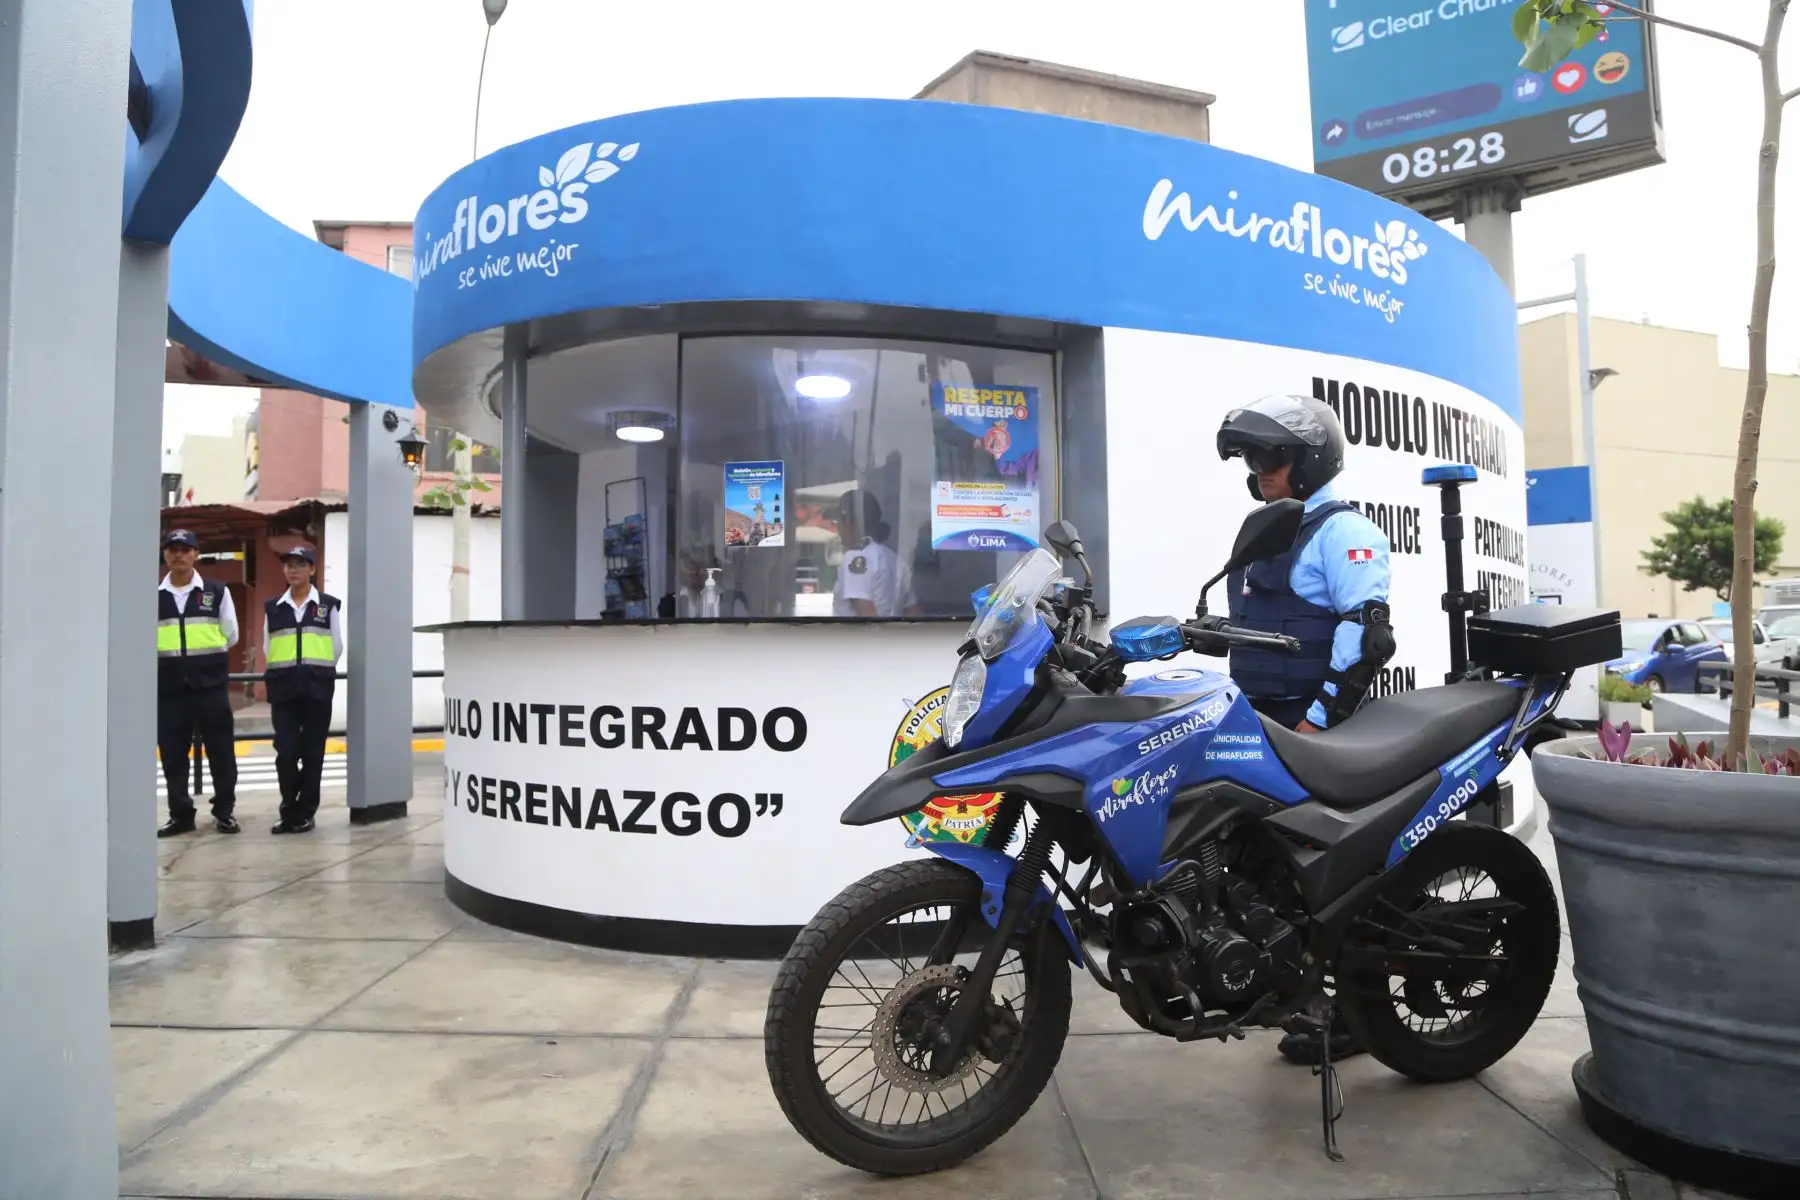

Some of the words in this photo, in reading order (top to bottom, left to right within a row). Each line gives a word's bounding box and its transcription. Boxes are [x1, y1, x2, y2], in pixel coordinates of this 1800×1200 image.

[1368, 9, 1434, 39] Clear
[1382, 131, 1505, 184] 08:28
[458, 264, 477, 289] se
[480, 254, 513, 279] vive
[516, 239, 579, 277] mejor
[1303, 272, 1326, 295] se
[1328, 273, 1361, 304] vive
[1363, 287, 1404, 323] mejor
[944, 387, 1027, 406] RESPETA
[944, 403, 963, 416] MI
[1433, 401, 1508, 479] INTEGRADO
[980, 538, 1006, 547] LIMA
[492, 702, 808, 753] INTEGRADO
[1138, 701, 1225, 756] SERENAZGO
[1205, 752, 1215, 760] DE
[1216, 751, 1263, 760] MIRAFLORES
[1095, 764, 1179, 822] Miraflores
[1405, 778, 1478, 847] 350-9090
[944, 818, 983, 829] PATRIA
